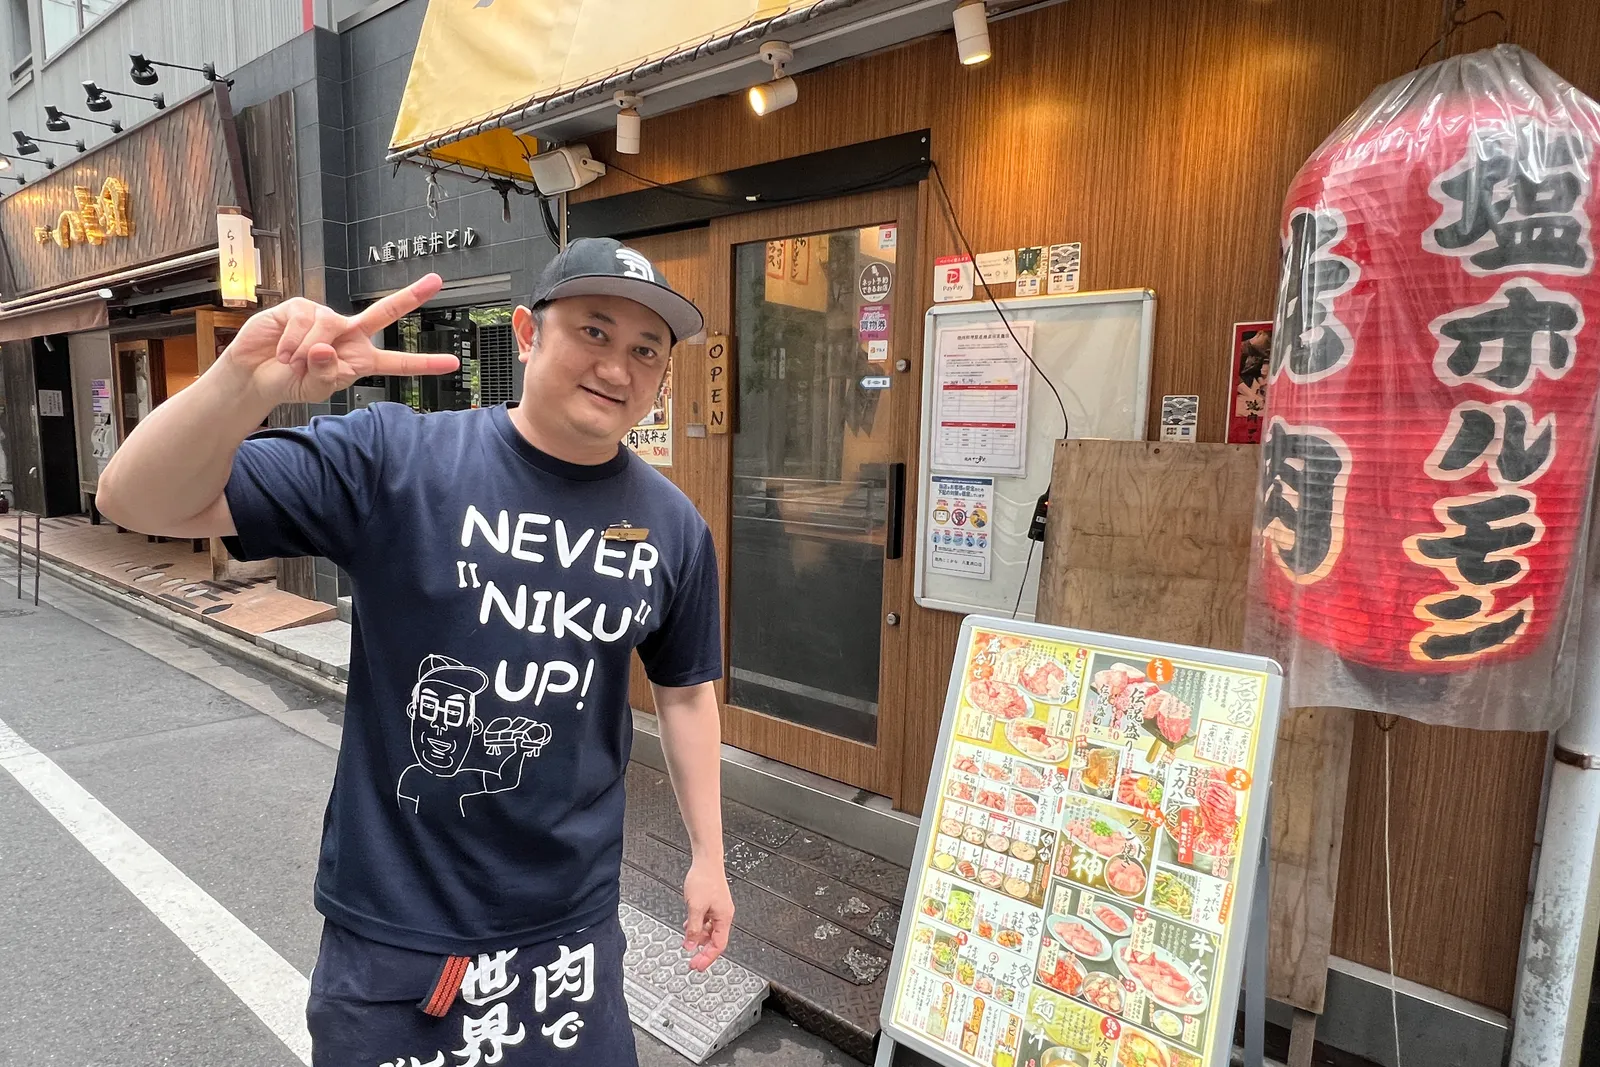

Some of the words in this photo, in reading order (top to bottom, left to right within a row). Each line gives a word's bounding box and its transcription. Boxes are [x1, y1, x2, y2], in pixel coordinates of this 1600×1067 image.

[227, 229, 239, 282] らーめん
[367, 227, 475, 263] 八重洲境井ビル
[708, 344, 725, 426] OPEN
[1408, 128, 1592, 660] 塩ホルモン
[460, 504, 659, 587] NEVER
[494, 658, 595, 711] UP!
[1226, 676, 1258, 728] 名物
[1123, 687, 1146, 752] 伝説盛り
[1165, 763, 1188, 827] デカハラミ
[1184, 765, 1199, 799] BBQ
[1070, 846, 1104, 884] 神
[531, 942, 595, 1049] 肉で
[1185, 931, 1214, 1002] 牛たん
[450, 947, 526, 1067] 世界
